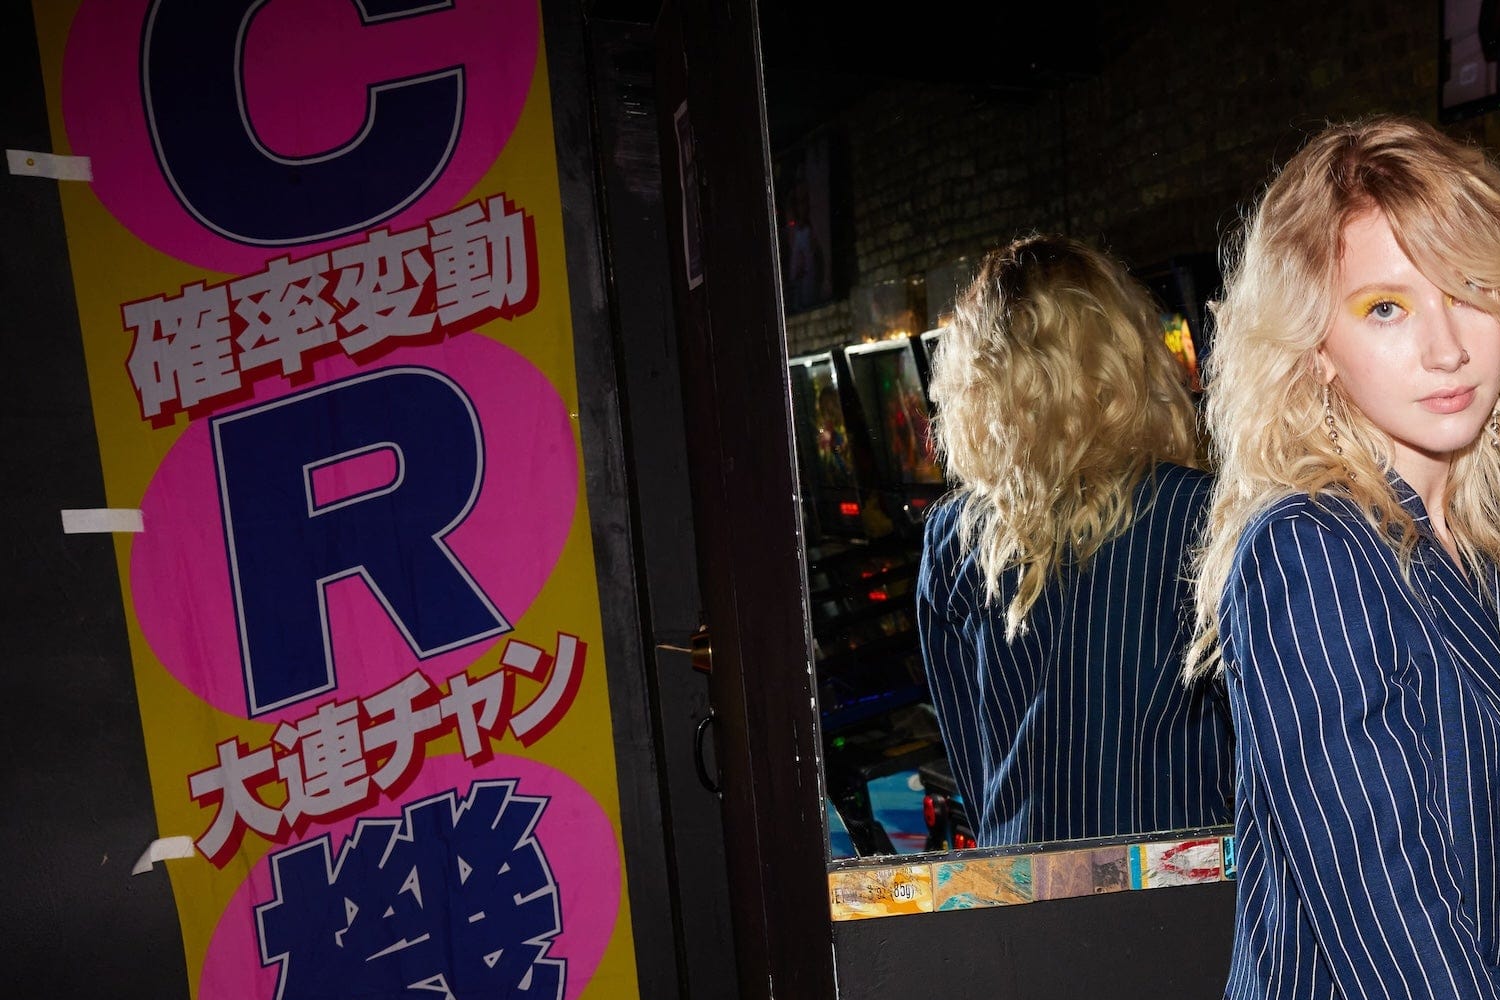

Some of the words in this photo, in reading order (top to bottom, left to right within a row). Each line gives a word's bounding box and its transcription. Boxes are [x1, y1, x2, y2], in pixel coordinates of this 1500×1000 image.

[139, 0, 468, 249] C
[121, 193, 539, 429] 確率変動
[210, 365, 514, 718] R
[187, 631, 588, 869] 大連チャン
